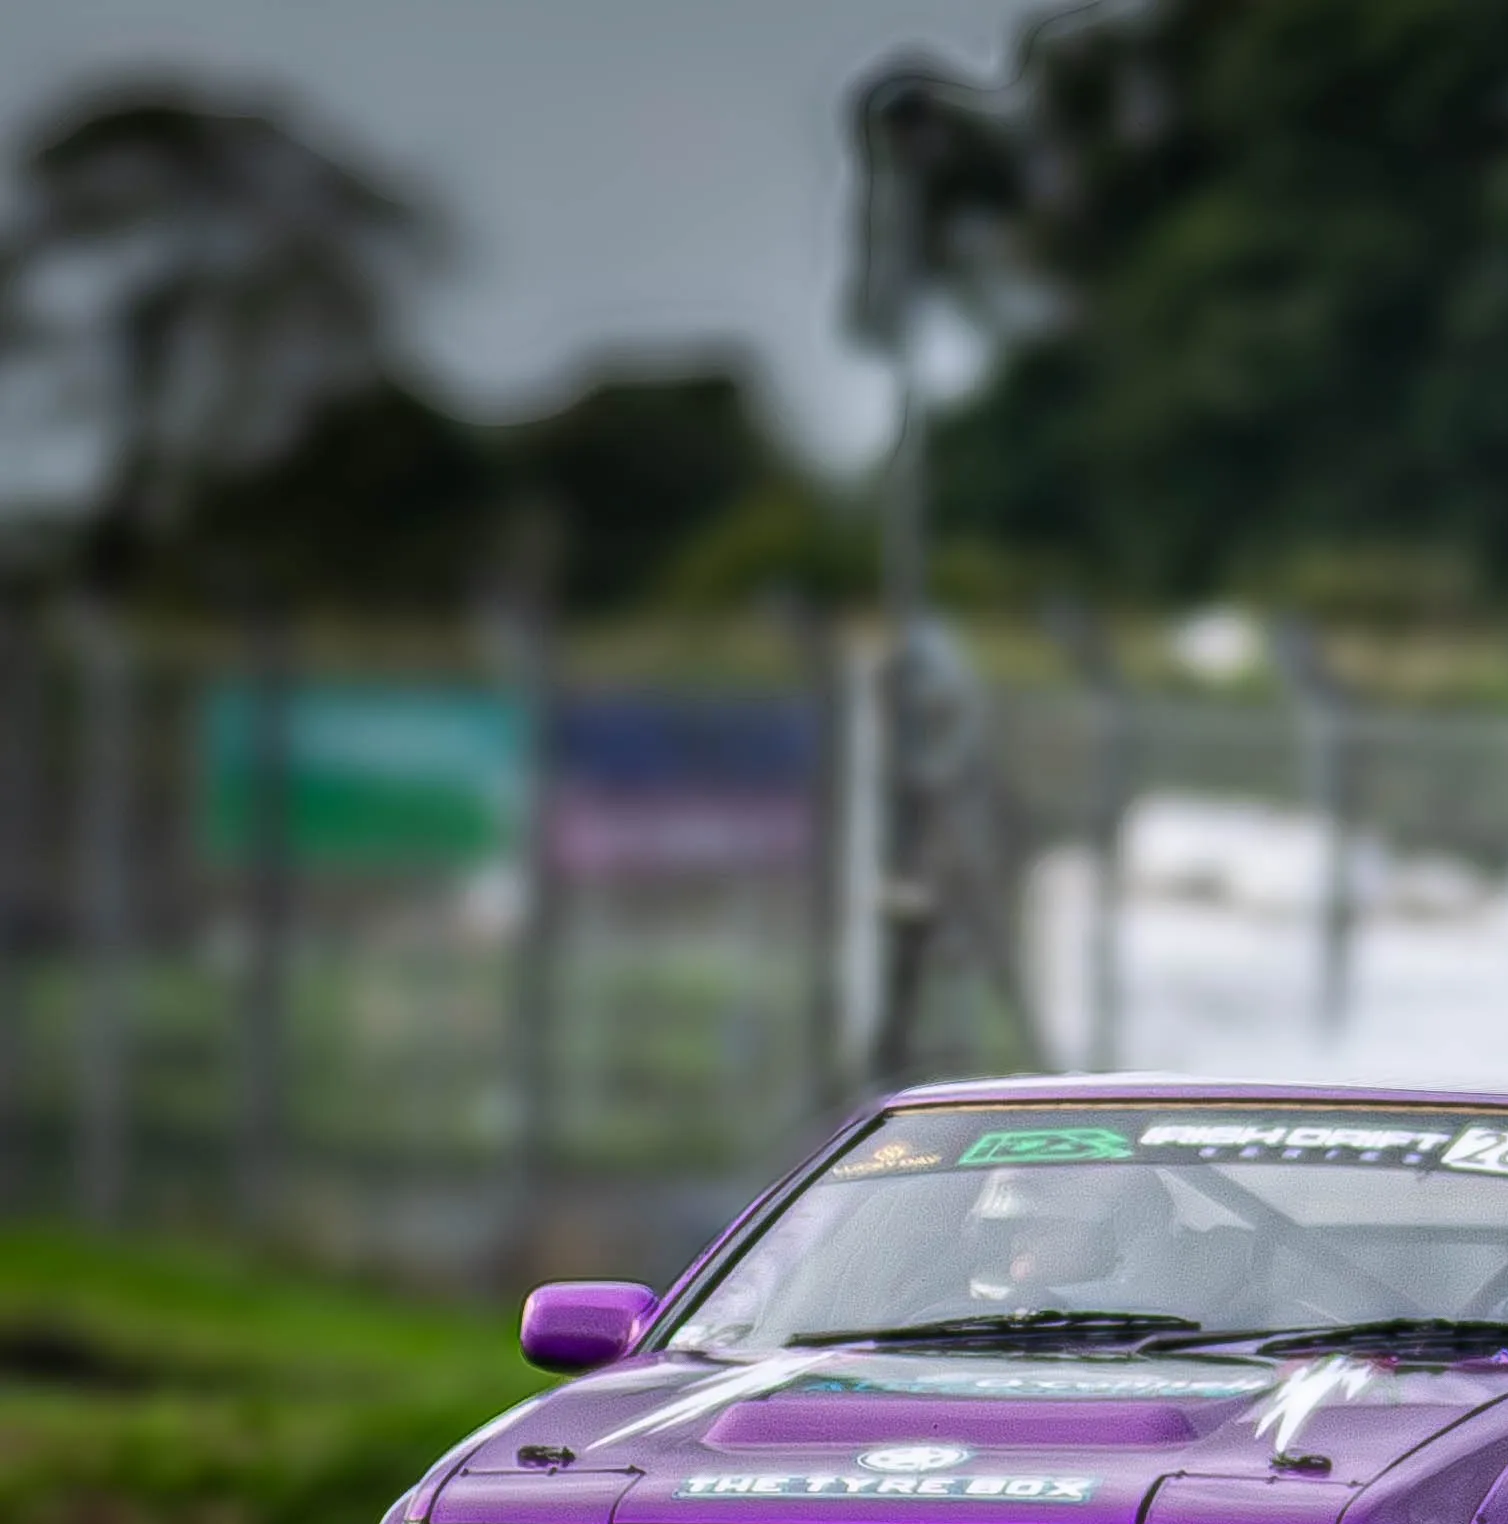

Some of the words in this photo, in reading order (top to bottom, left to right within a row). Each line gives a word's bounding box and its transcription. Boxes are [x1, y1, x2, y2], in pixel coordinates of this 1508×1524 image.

[1285, 1128, 1451, 1151] DRIFT
[688, 1475, 787, 1495] THE
[803, 1476, 956, 1497] TYRE
[965, 1477, 1089, 1498] BOX
